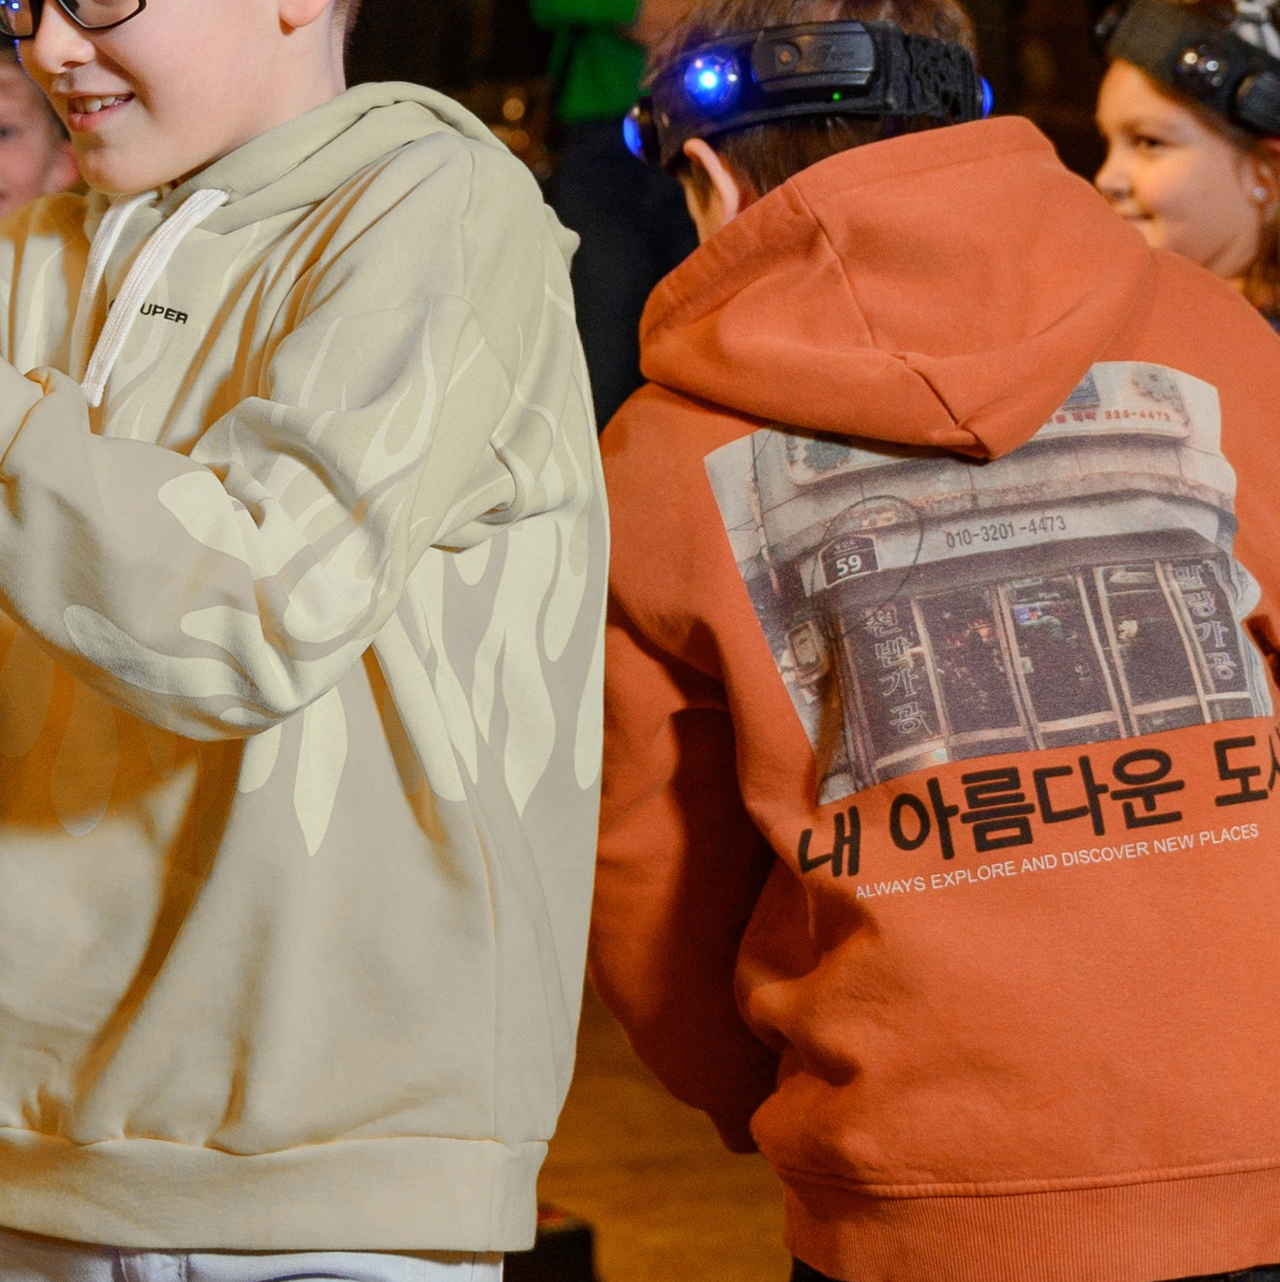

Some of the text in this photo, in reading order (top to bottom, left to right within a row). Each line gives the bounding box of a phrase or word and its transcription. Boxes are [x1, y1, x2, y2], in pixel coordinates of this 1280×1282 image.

[109, 300, 188, 324] UPER
[835, 554, 862, 577] 59
[798, 805, 861, 877] 내
[889, 748, 1185, 860] 아름다운
[856, 823, 1259, 900] ALWAYS EXPLORE AND DISCOVER NEW PLACES
